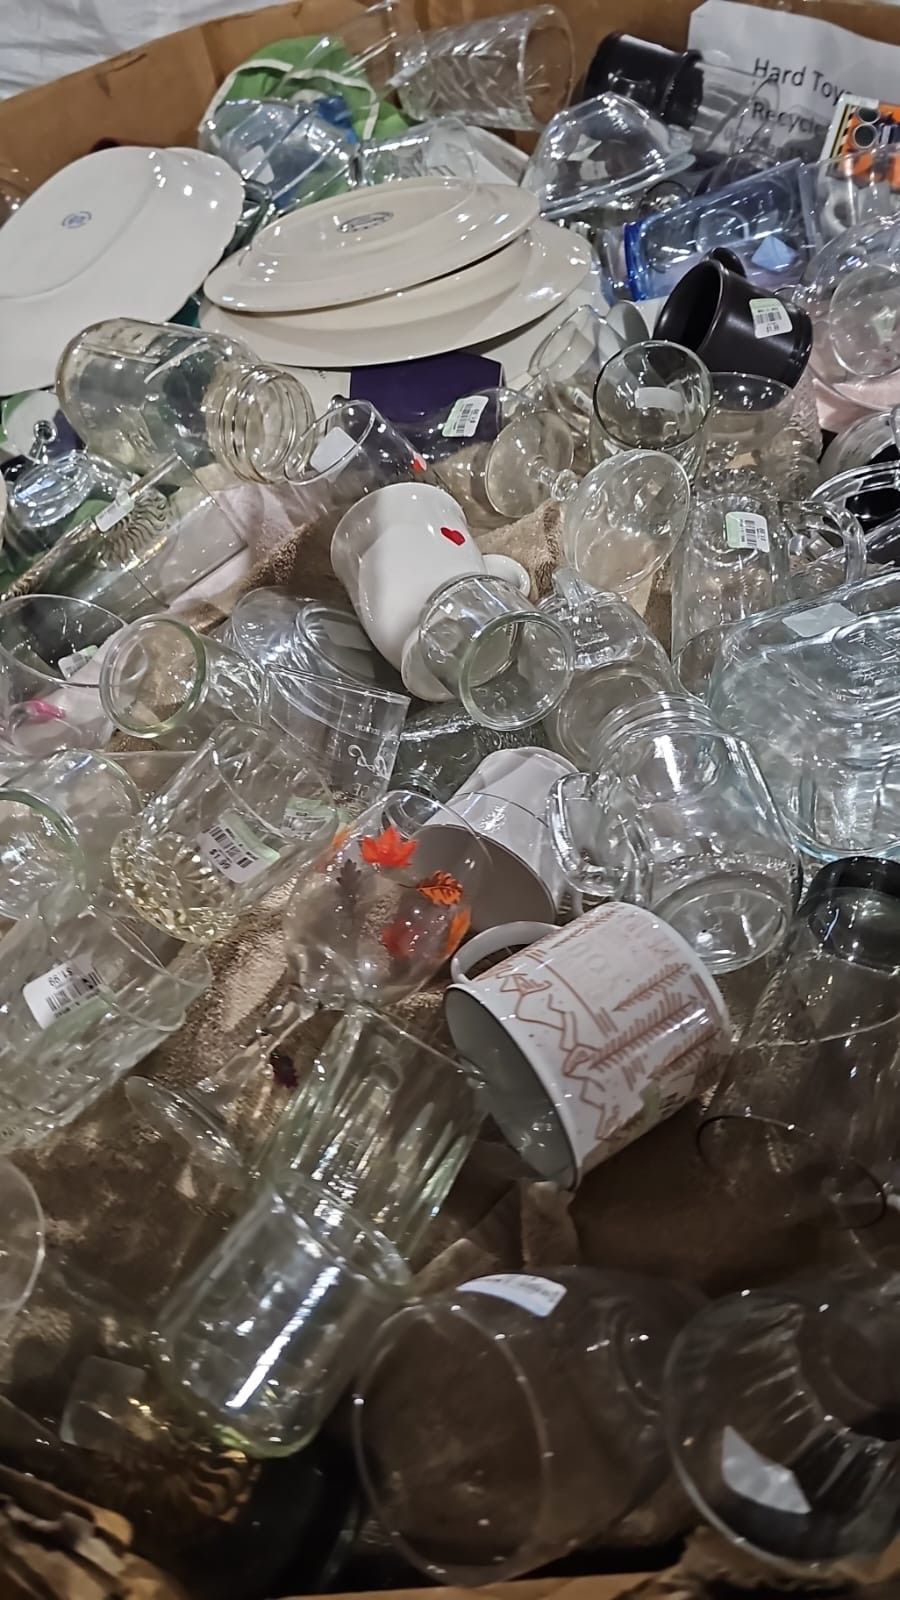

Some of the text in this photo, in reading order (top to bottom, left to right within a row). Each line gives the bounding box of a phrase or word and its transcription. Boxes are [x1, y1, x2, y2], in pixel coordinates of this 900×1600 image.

[753, 57, 853, 106] Hard Toy
[208, 848, 231, 869] $1.99
[48, 967, 73, 987] $1.99
